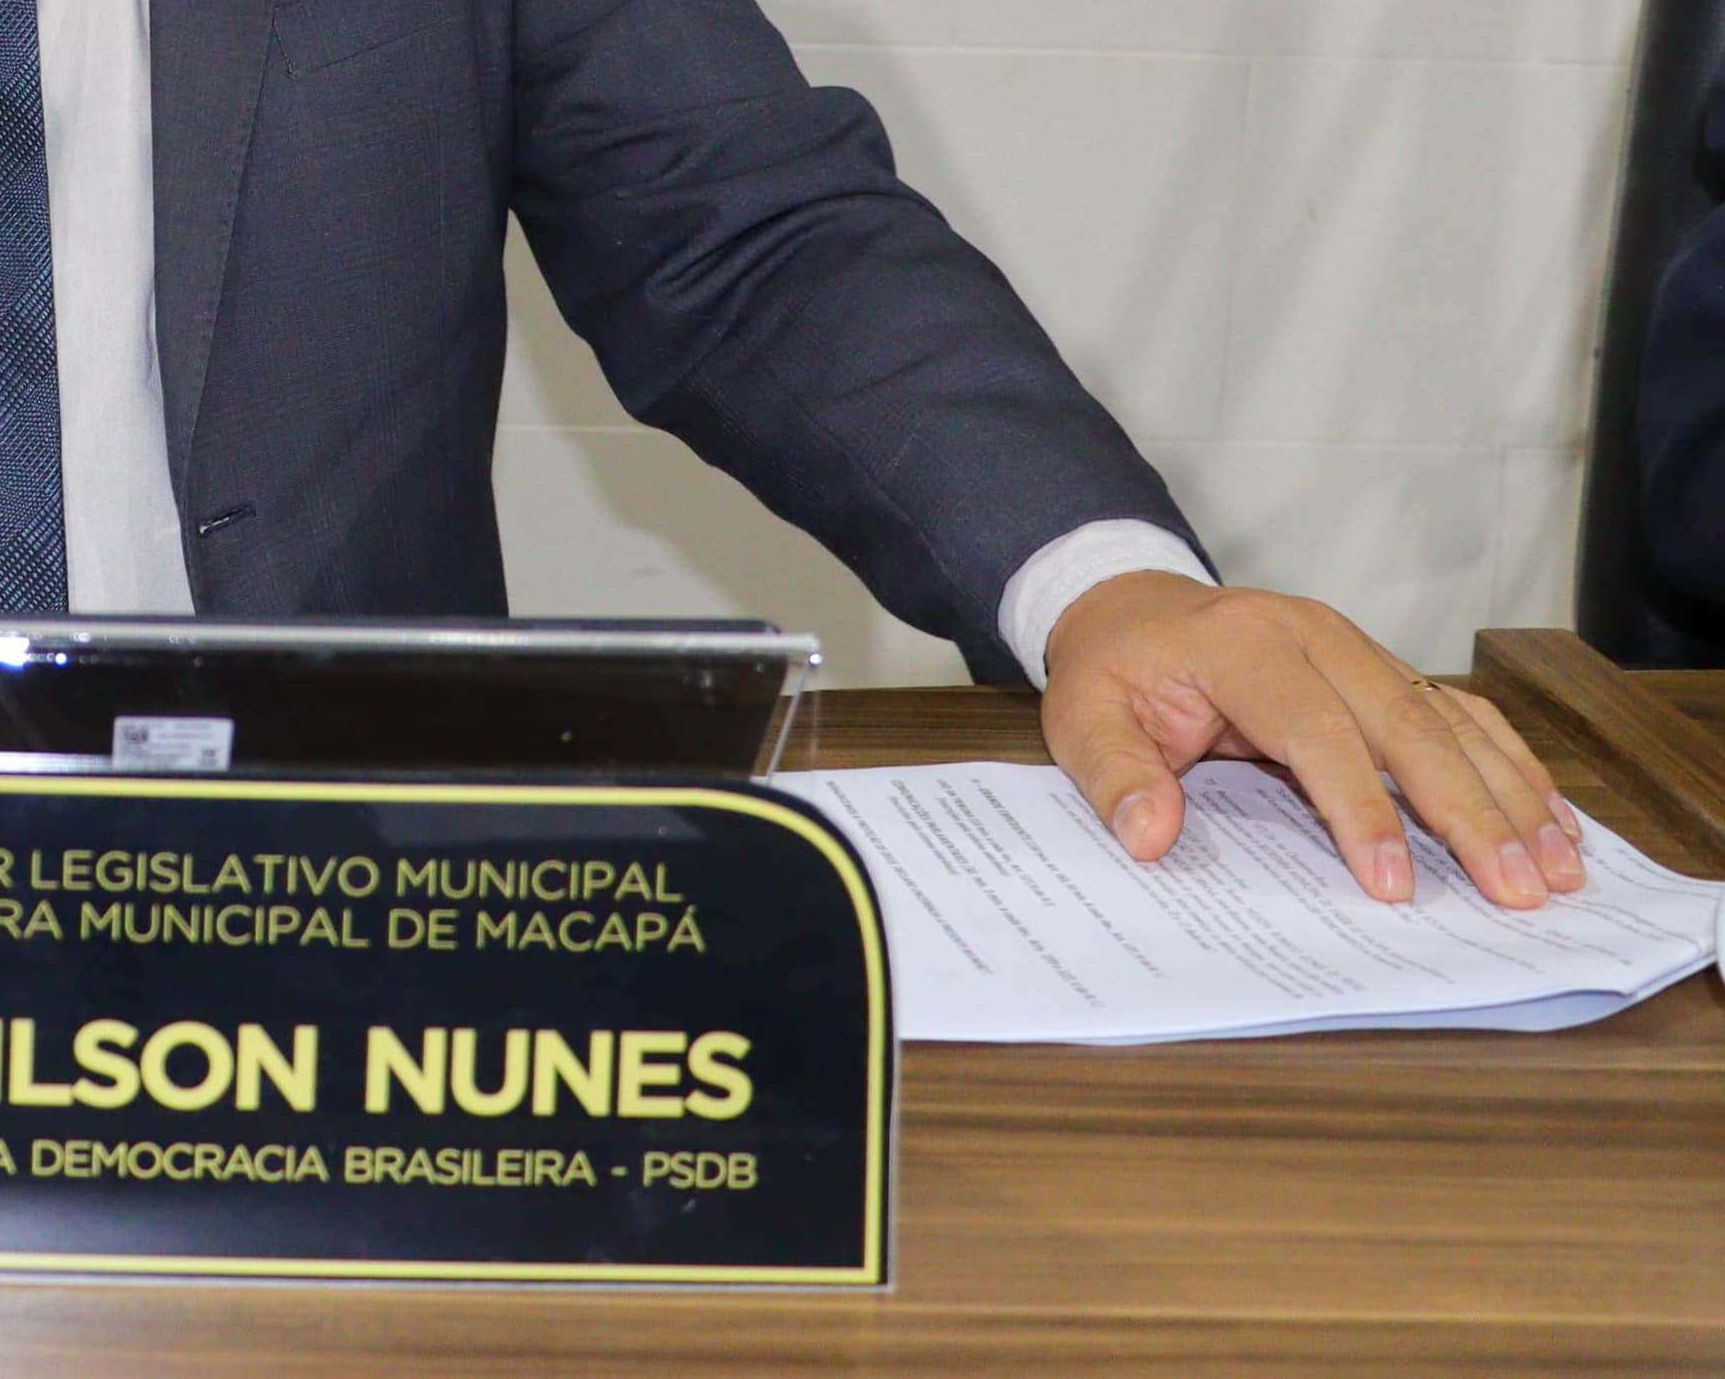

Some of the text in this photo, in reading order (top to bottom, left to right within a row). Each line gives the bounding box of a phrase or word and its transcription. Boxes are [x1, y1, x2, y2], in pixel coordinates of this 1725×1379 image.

[31, 850, 379, 897] LEGISLATIVO
[397, 859, 681, 902] MUNICIPAL
[81, 902, 368, 947] MUNICIPAL
[389, 909, 455, 948] DE
[477, 906, 704, 951] MACAPÁ
[365, 1026, 752, 1119] NUNES
[32, 1139, 329, 1182] DEMOCRACIA
[345, 1147, 595, 1186] BRASILEIRA
[643, 1152, 756, 1188] PSDB
